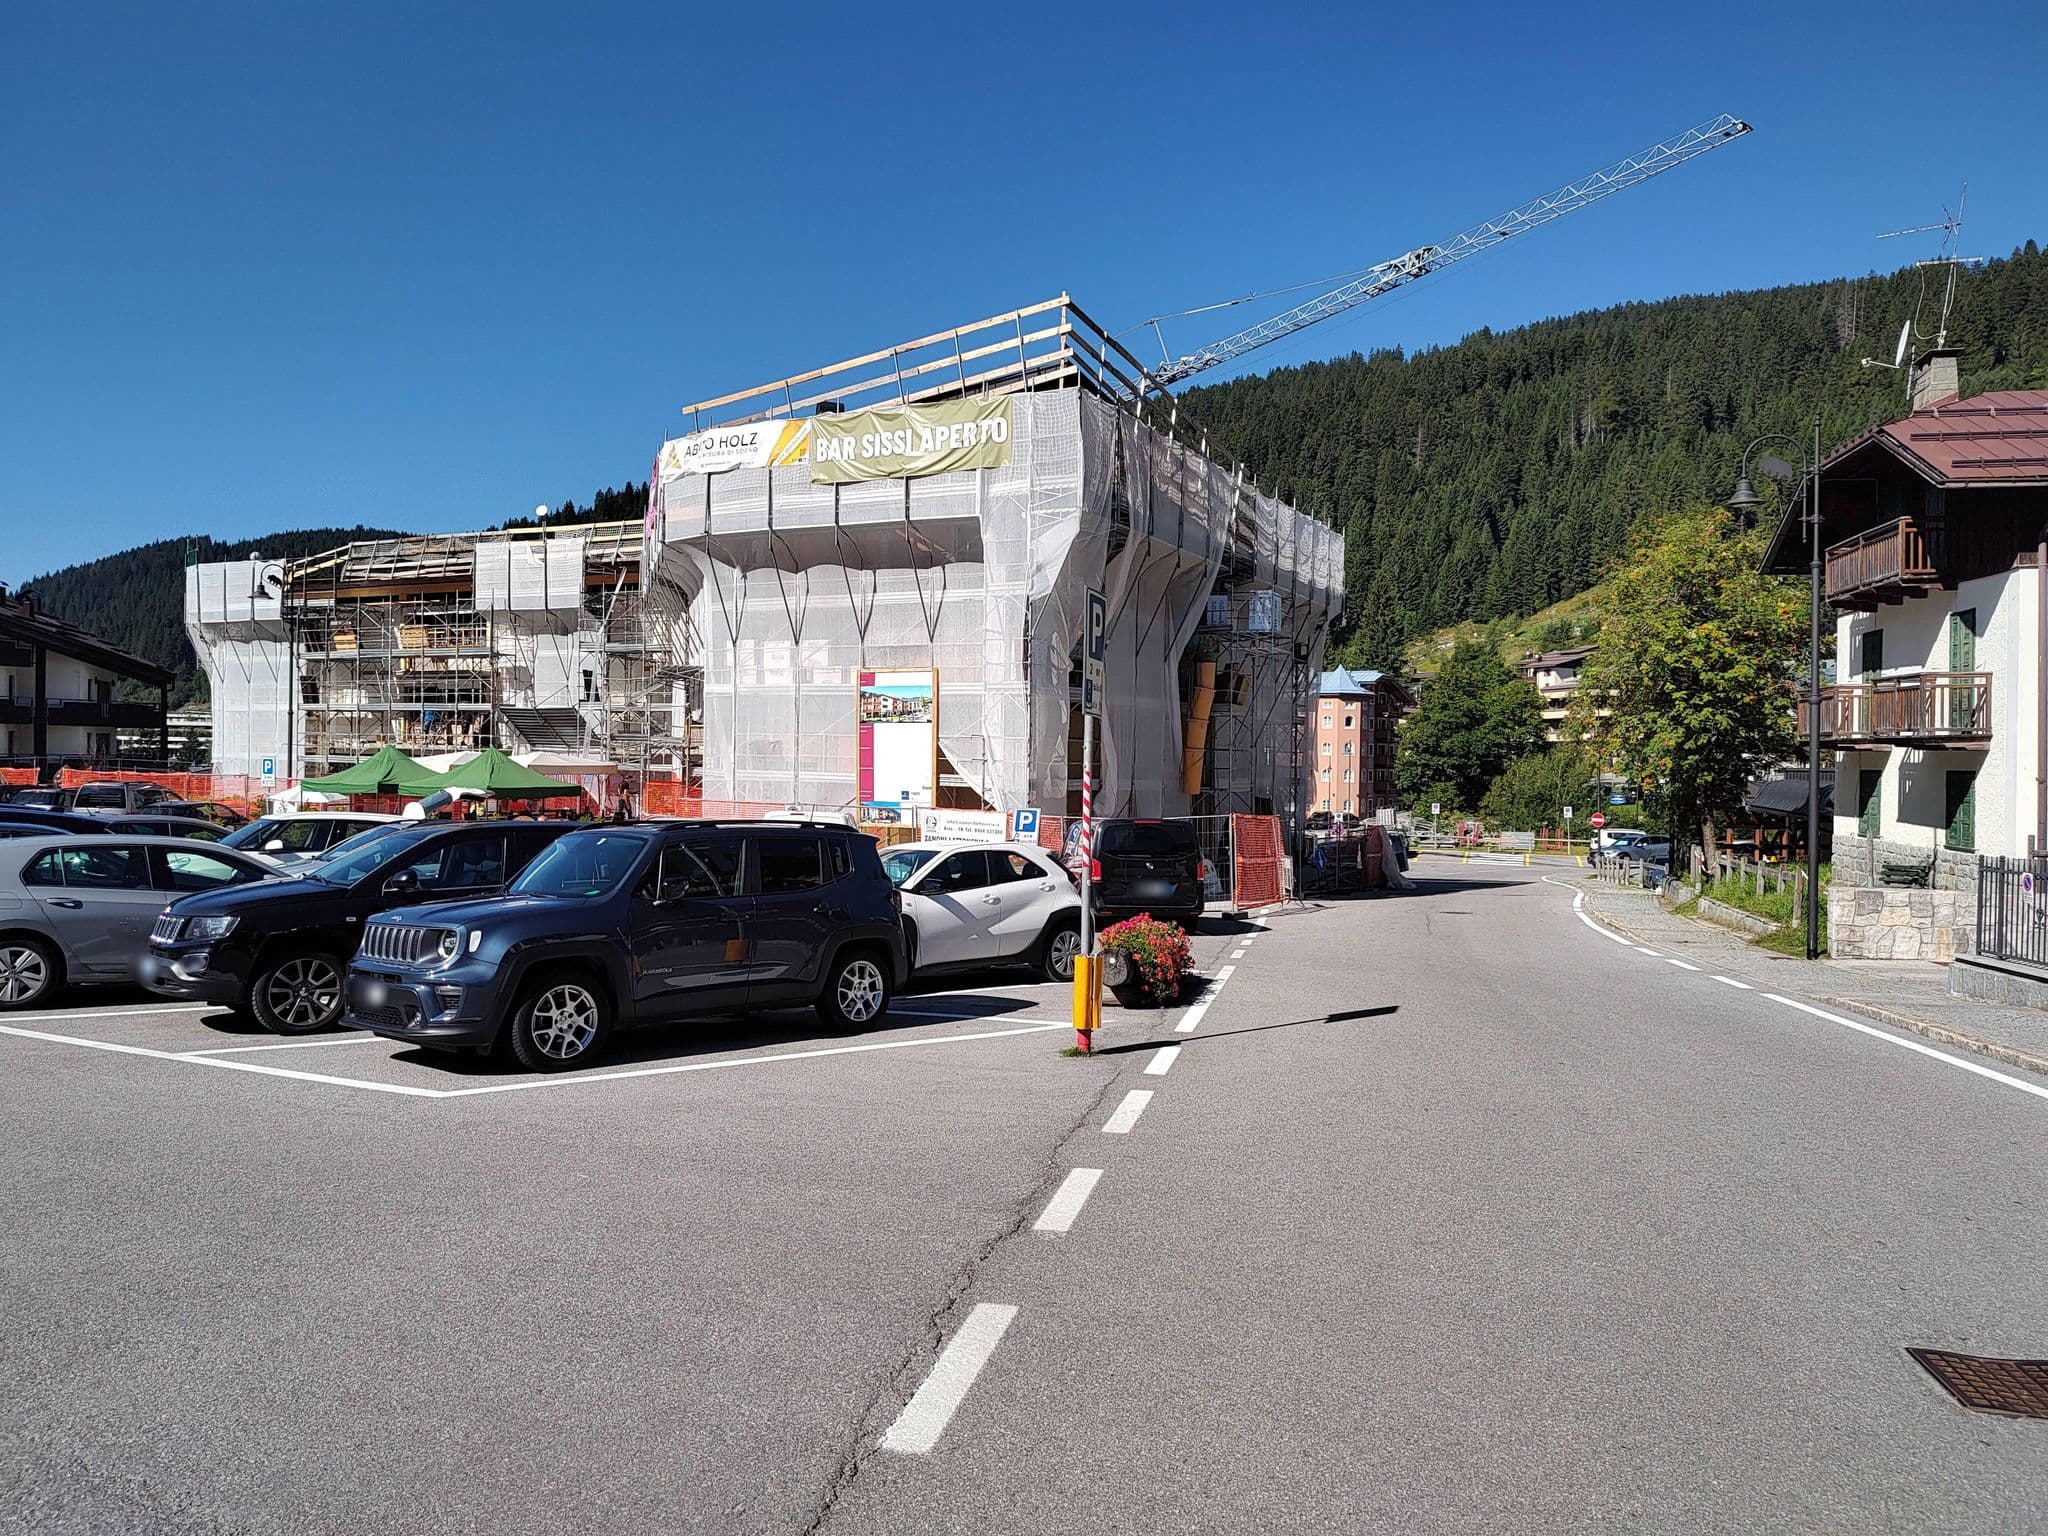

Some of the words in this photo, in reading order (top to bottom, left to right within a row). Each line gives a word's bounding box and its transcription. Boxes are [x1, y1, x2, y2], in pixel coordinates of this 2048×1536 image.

[719, 432, 758, 448] HOLZ
[816, 435, 857, 463] BAR
[861, 428, 914, 459] SISSI
[919, 416, 1009, 453] APERTO
[1092, 602, 1103, 653] P
[265, 761, 271, 772] P
[1018, 812, 1033, 830] P
